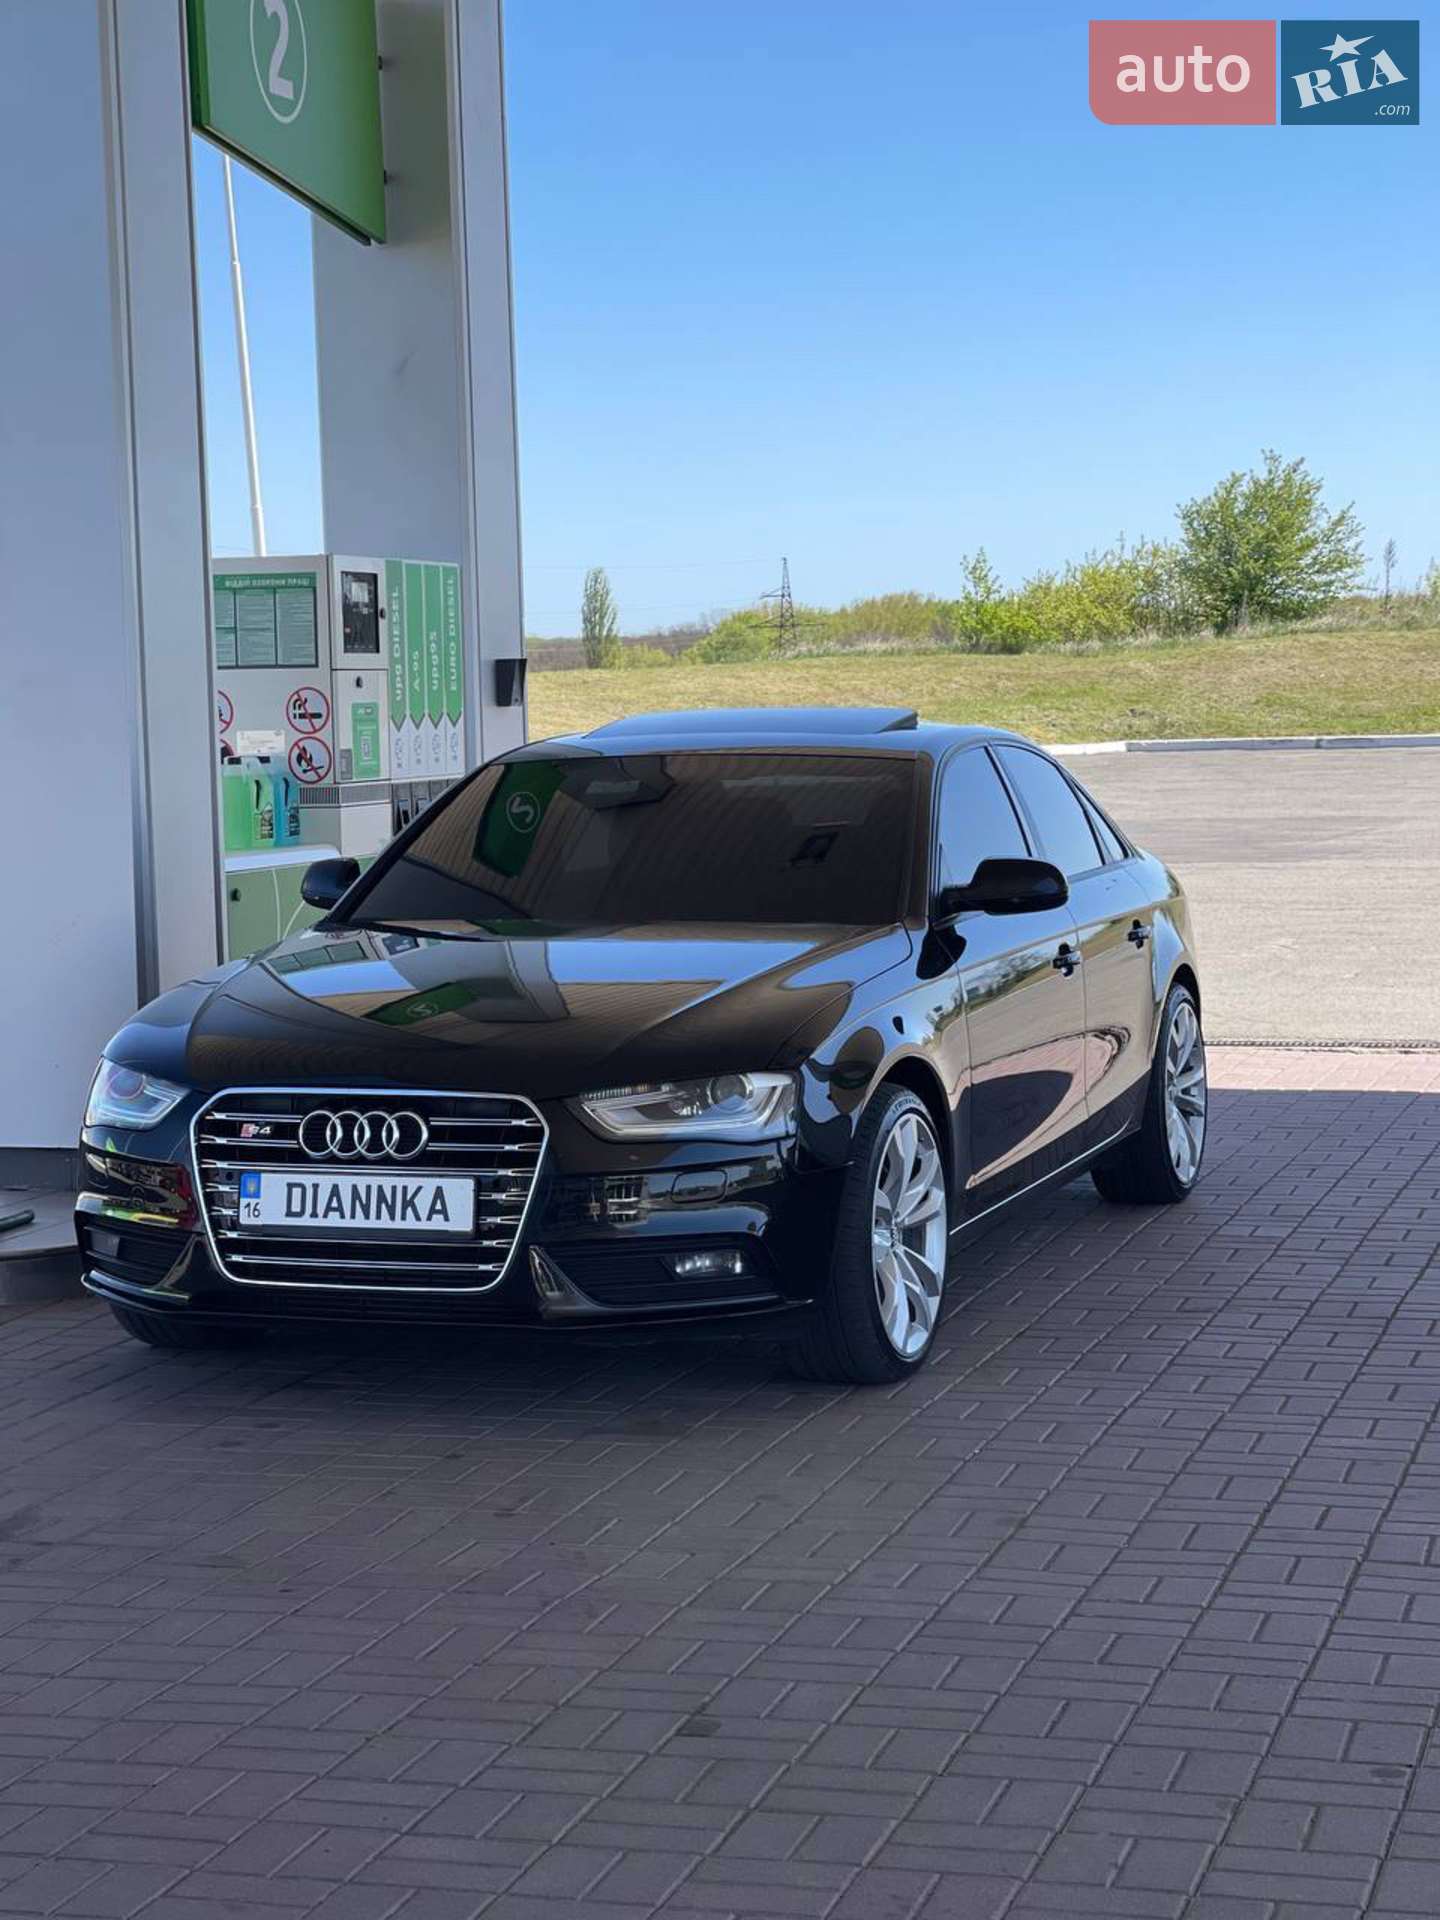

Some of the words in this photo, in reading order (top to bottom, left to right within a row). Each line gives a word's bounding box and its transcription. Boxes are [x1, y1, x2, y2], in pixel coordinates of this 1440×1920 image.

[264, 0, 294, 100] 2
[392, 586, 400, 657] DIESEL
[244, 1202, 261, 1219] 16
[285, 1181, 450, 1222] DIANNKA
